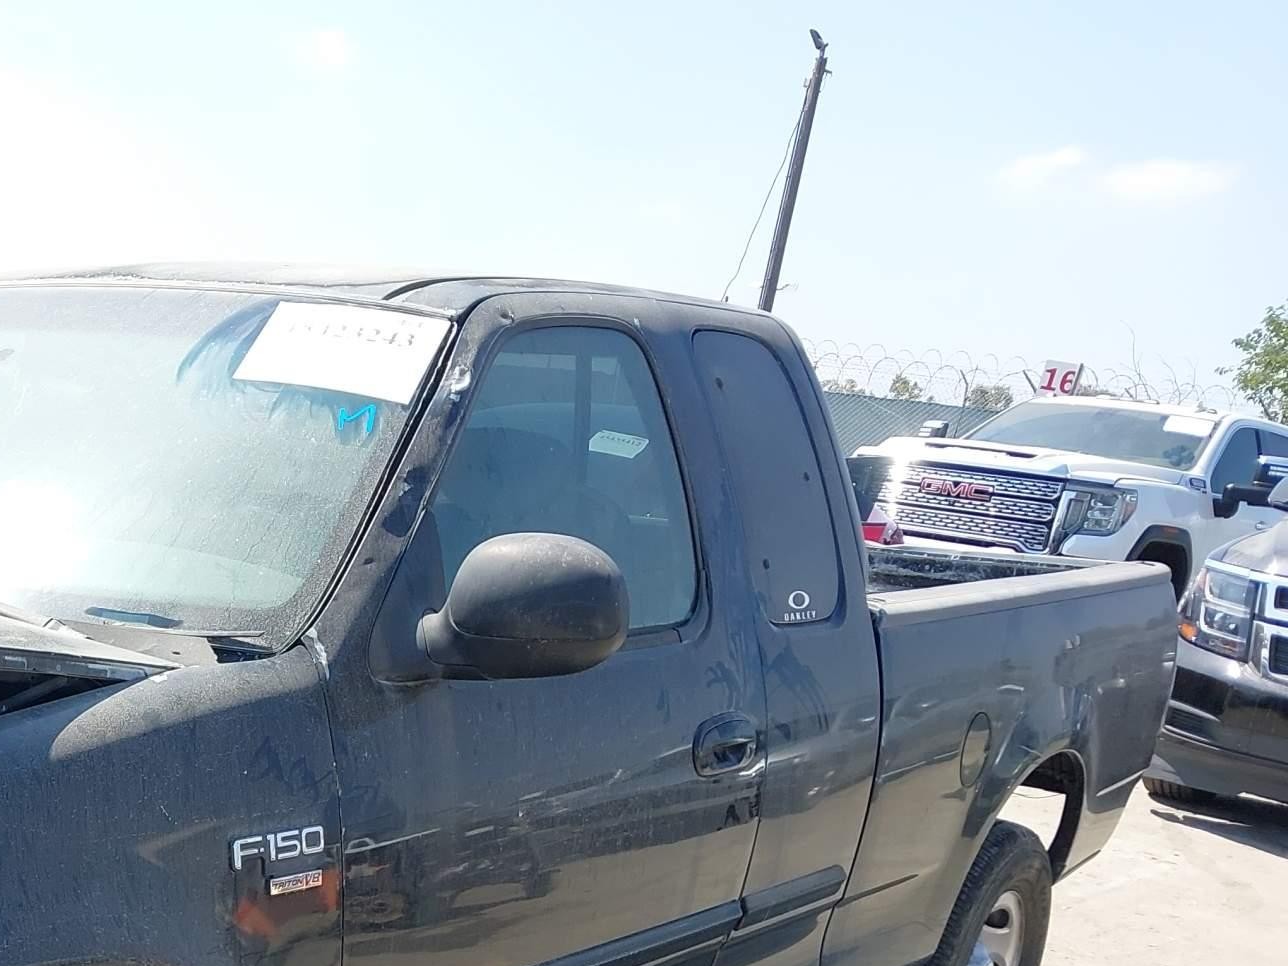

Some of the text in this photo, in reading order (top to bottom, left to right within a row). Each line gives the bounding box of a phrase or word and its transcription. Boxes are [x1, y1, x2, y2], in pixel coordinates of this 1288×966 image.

[1039, 367, 1077, 395] 16
[920, 478, 994, 502] GMC
[784, 610, 817, 622] OAKLEY
[272, 872, 321, 891] TRITON V8
